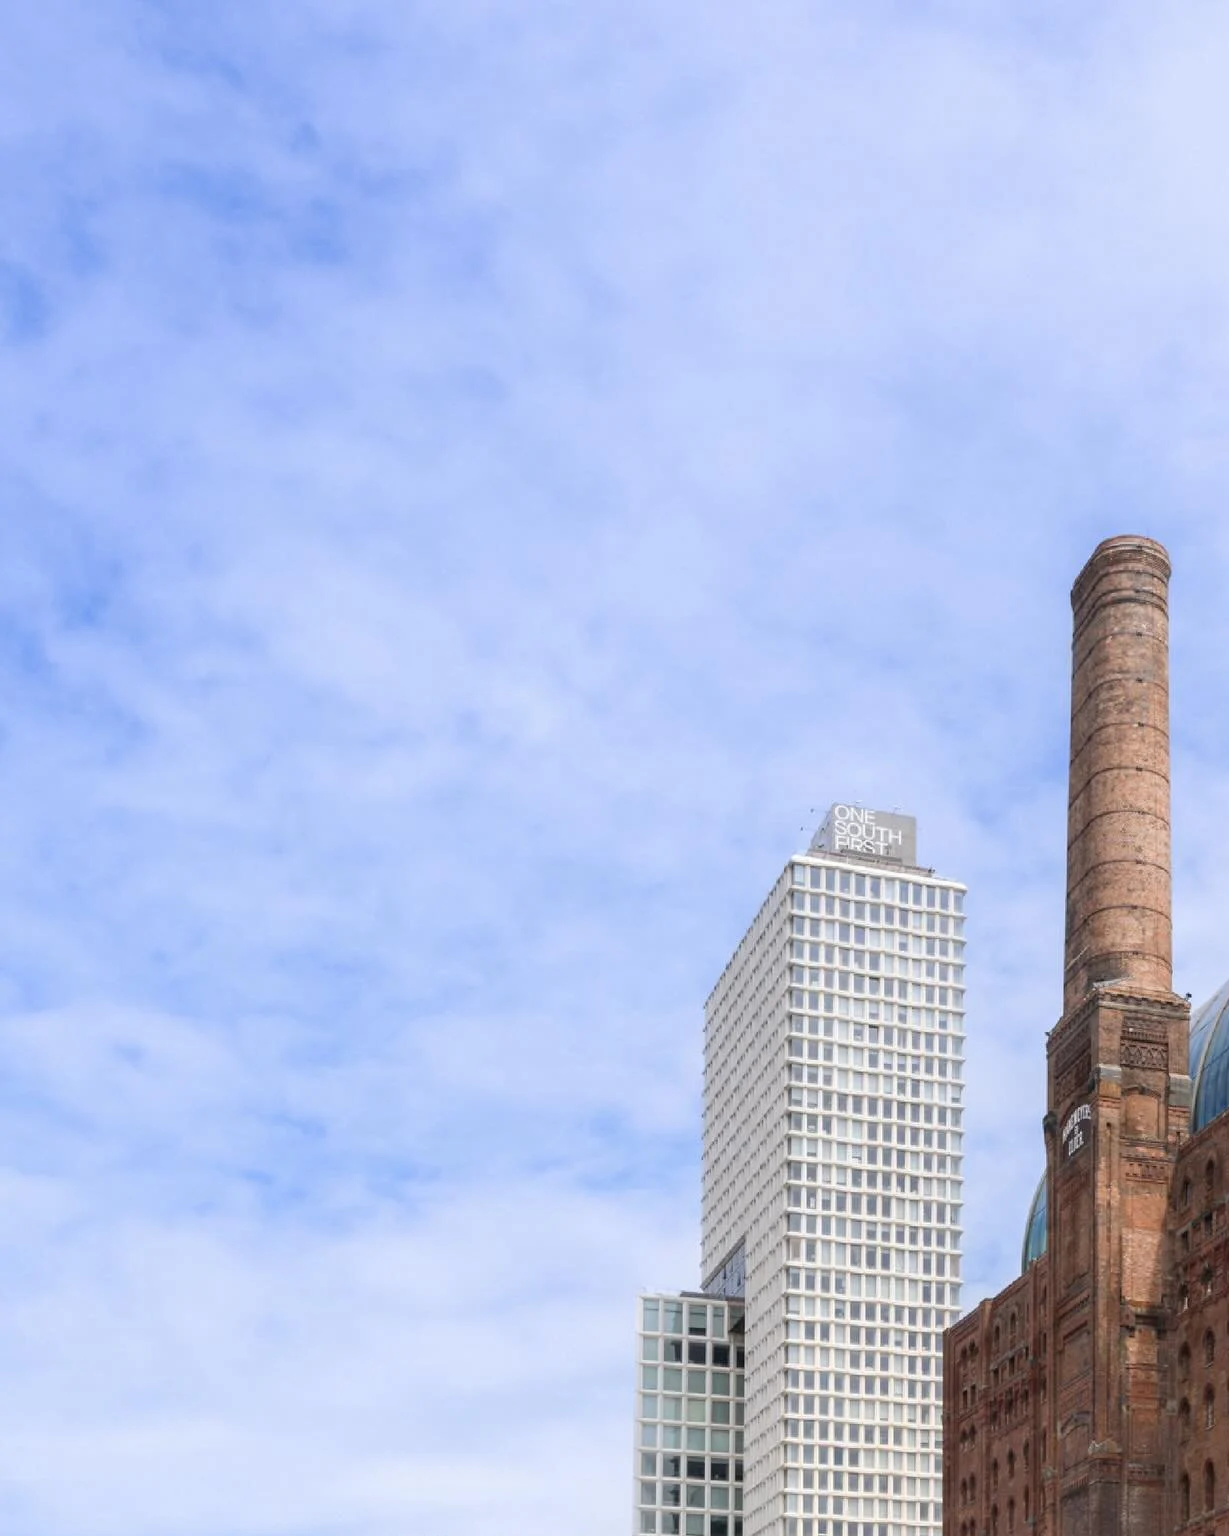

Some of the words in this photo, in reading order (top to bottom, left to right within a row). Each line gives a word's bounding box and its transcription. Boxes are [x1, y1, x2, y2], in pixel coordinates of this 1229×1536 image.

[834, 804, 876, 826] ONE
[834, 820, 902, 845] SOUTH
[834, 835, 889, 856] FIRST
